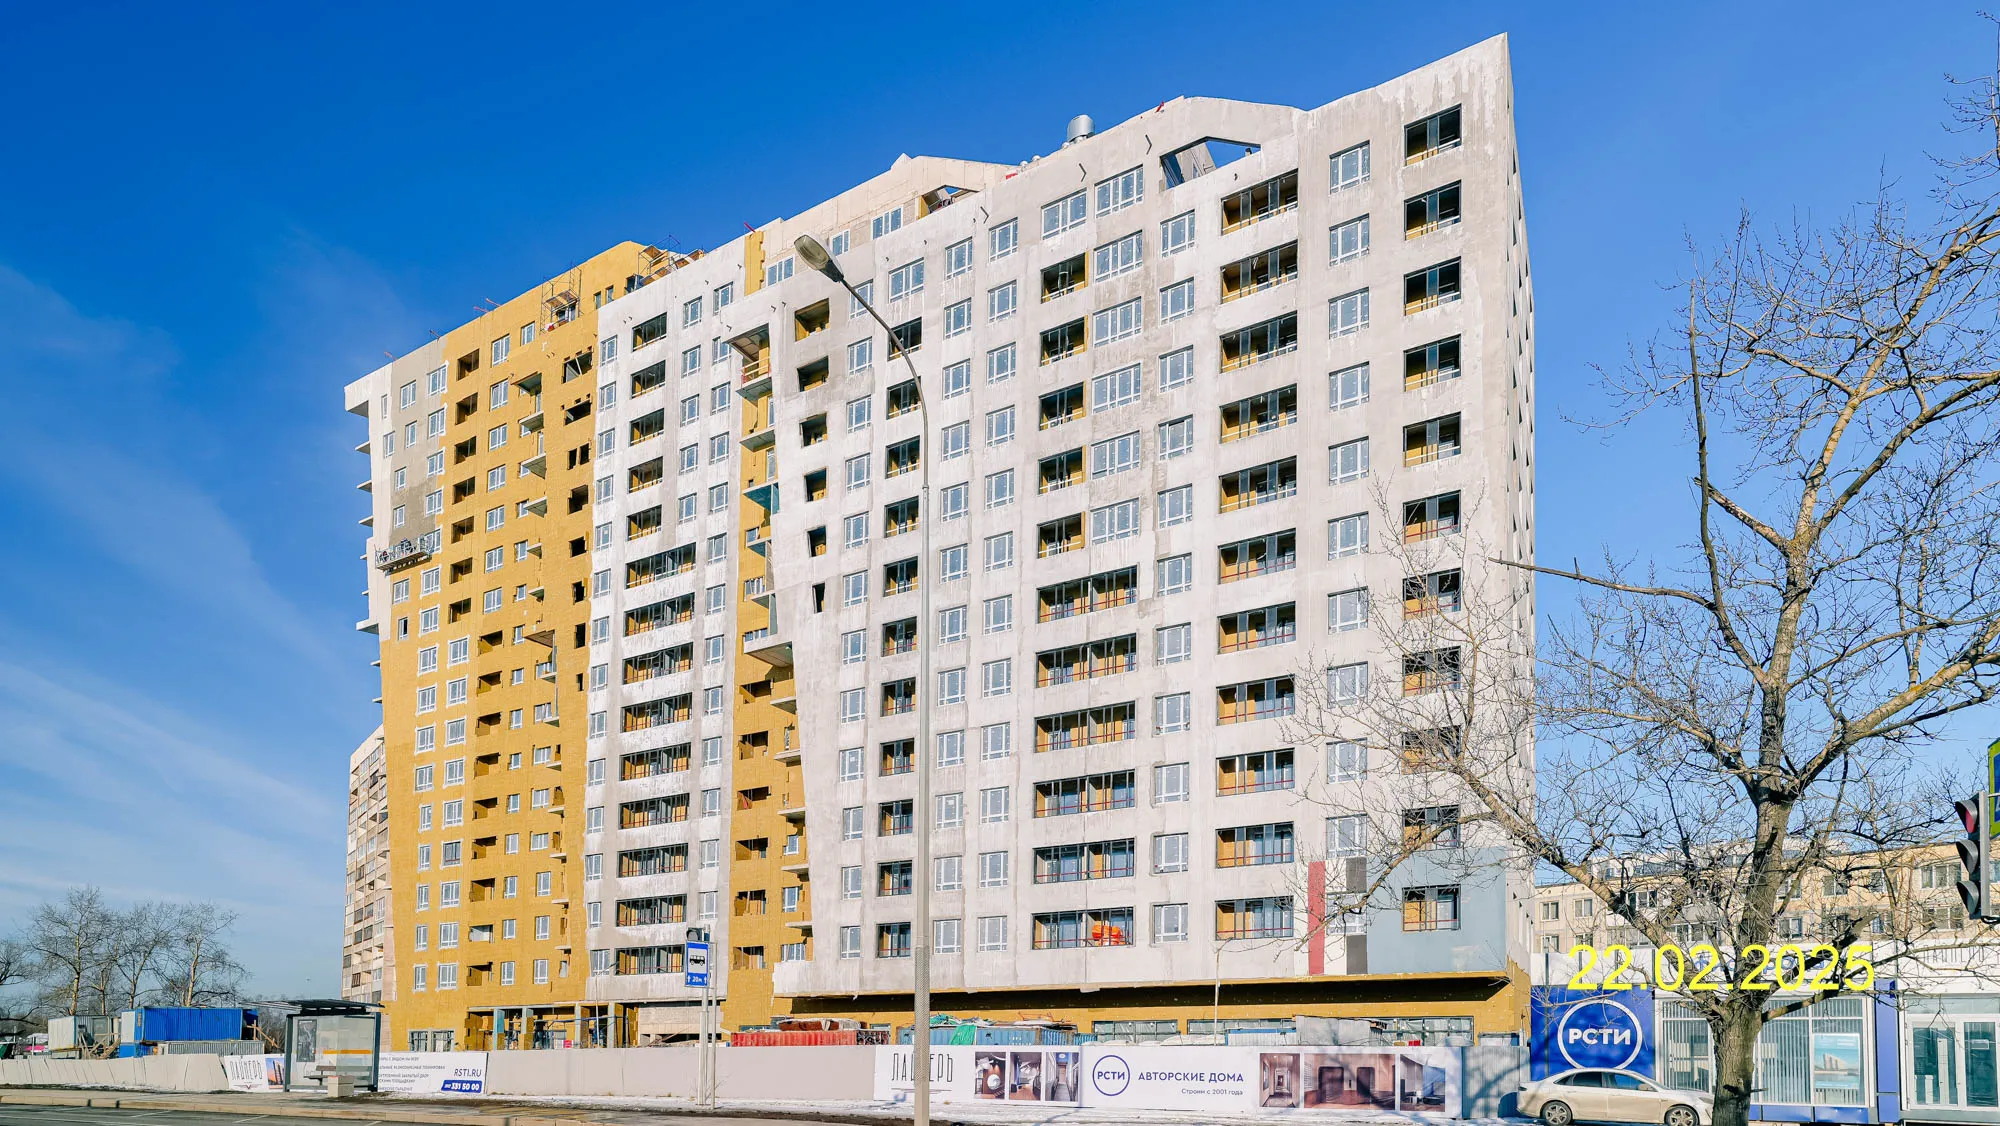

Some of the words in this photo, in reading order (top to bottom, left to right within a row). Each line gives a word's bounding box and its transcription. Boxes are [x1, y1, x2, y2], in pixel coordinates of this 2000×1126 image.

[1568, 1028, 1631, 1045] РСТИ
[454, 1068, 482, 1077] RSTI.RU
[1097, 1071, 1125, 1081] РСТИ
[1138, 1071, 1205, 1082] АВТОРСКИЕ
[1208, 1072, 1244, 1084] ДОМА
[1181, 1088, 1205, 1096] Строим
